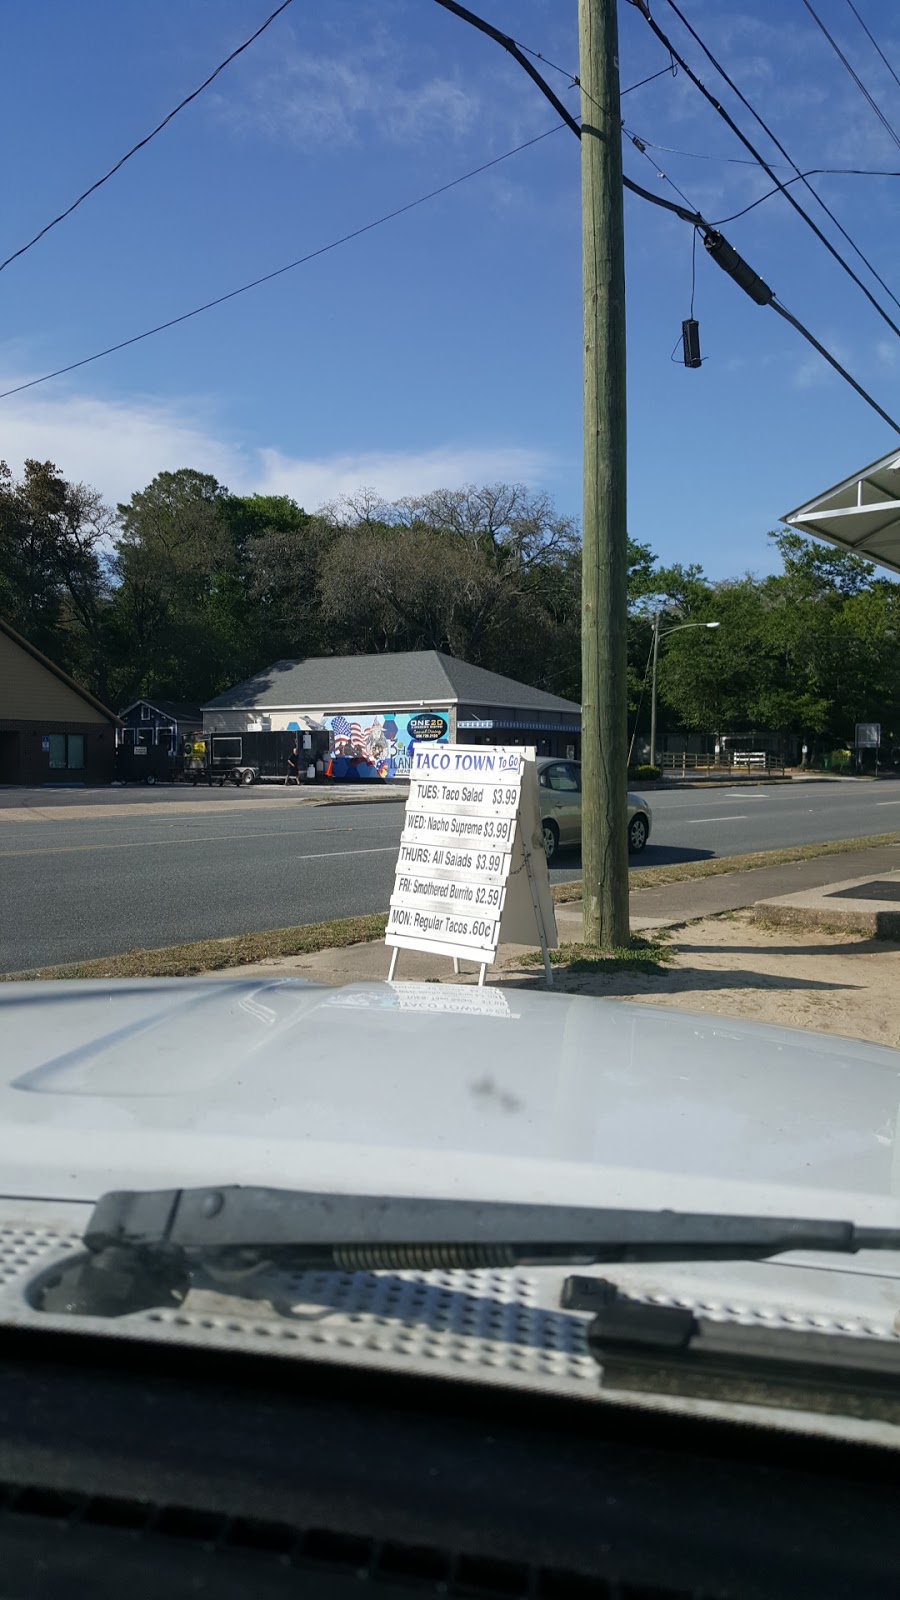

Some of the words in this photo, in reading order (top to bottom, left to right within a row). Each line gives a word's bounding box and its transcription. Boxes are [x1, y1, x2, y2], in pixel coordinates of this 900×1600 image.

[415, 753, 450, 770] TACO
[455, 754, 496, 771] TOWN
[498, 756, 507, 768] To
[508, 754, 519, 767] Go
[417, 784, 440, 799] TUES:
[442, 785, 460, 801] Taco
[461, 787, 484, 802] Salad
[492, 789, 517, 805] $3.99
[407, 814, 427, 829] WED:
[427, 816, 450, 832] Nacho
[450, 818, 483, 836] Supreme
[483, 820, 508, 838] $3.99
[400, 846, 431, 863] THURS:
[432, 850, 443, 864] All
[445, 852, 472, 868] Salads
[475, 854, 500, 872] $3.99
[398, 877, 412, 891] FRI:
[413, 880, 449, 897] Smothered
[449, 884, 474, 901] Burrito
[475, 887, 499, 905] $2.59
[391, 909, 413, 925] MON:
[413, 912, 444, 932] Regular
[444, 917, 468, 934] Tacos
